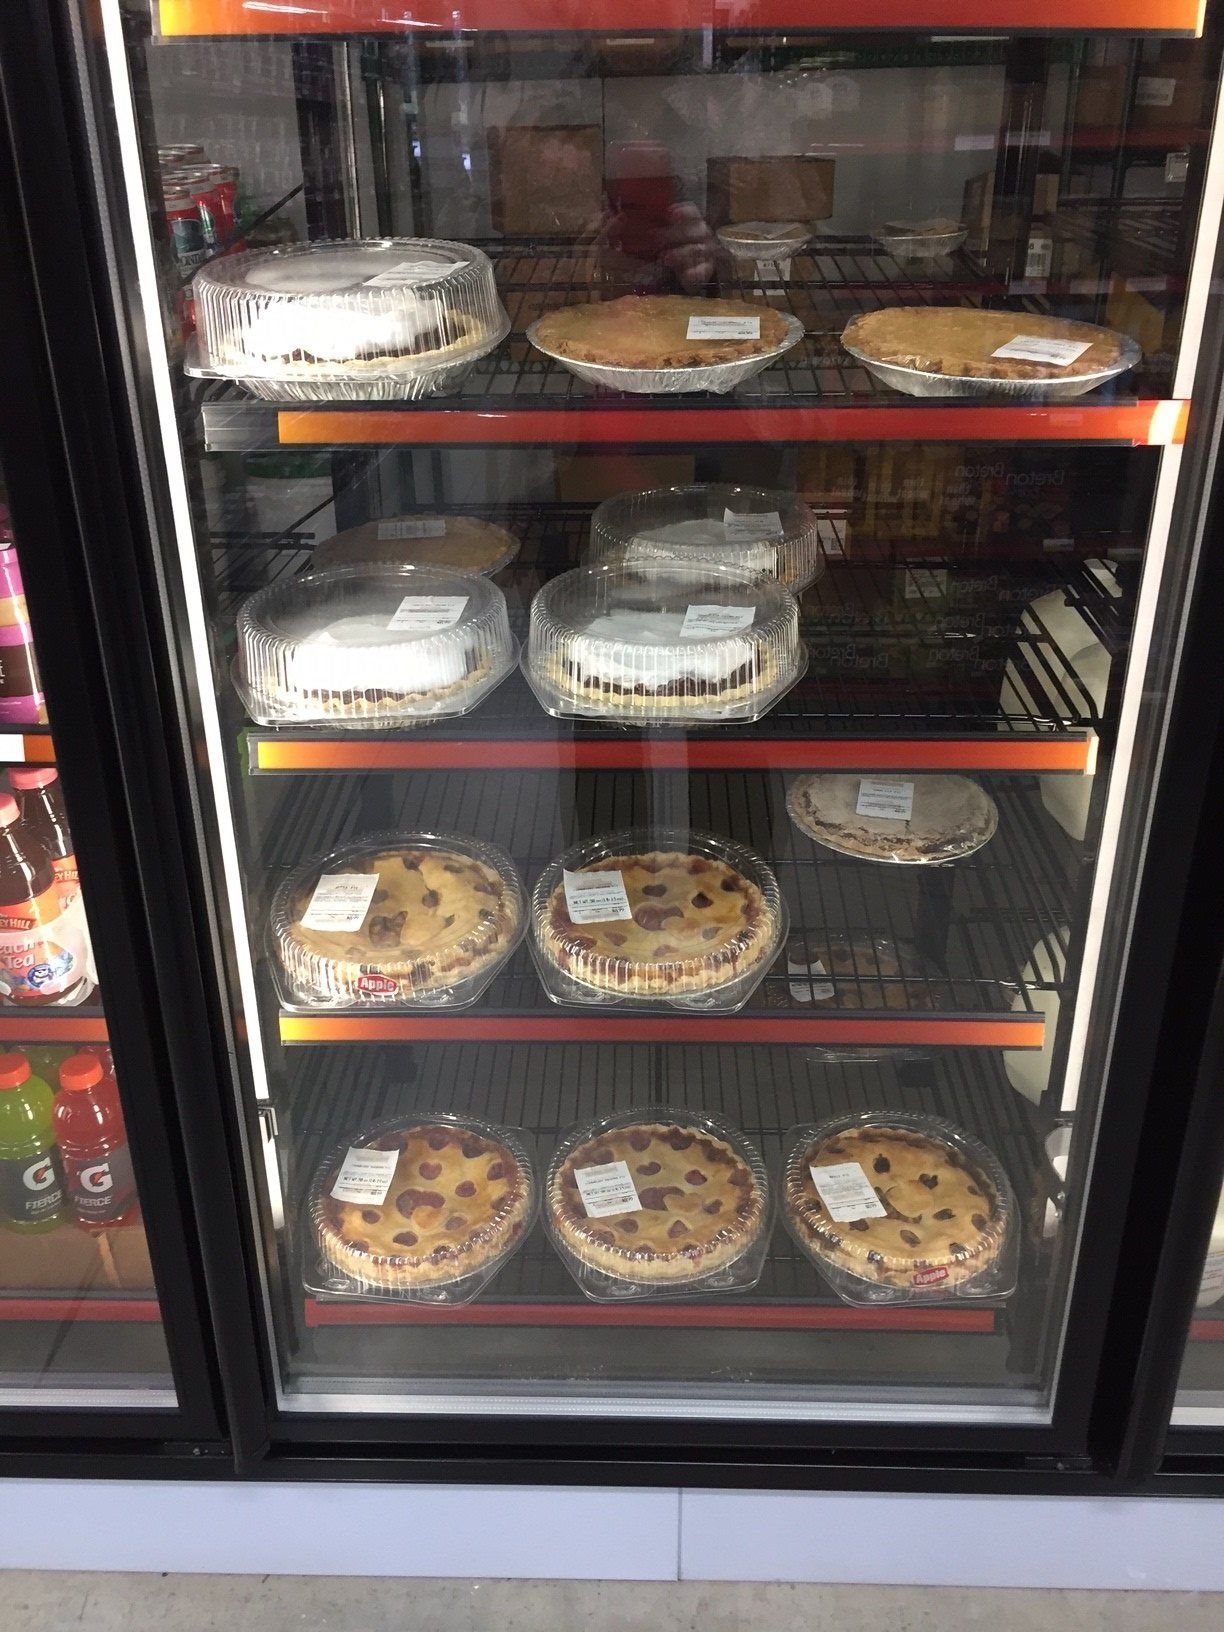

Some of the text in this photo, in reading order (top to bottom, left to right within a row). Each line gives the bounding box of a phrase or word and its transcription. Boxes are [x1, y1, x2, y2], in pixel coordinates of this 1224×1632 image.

[10, 918, 31, 930] HILL
[4, 953, 35, 970] Tea
[360, 977, 396, 992] Apple
[23, 1156, 55, 1191] G
[80, 1162, 113, 1193] G
[74, 1195, 112, 1208] FIERCE
[916, 1268, 946, 1285] Apple
